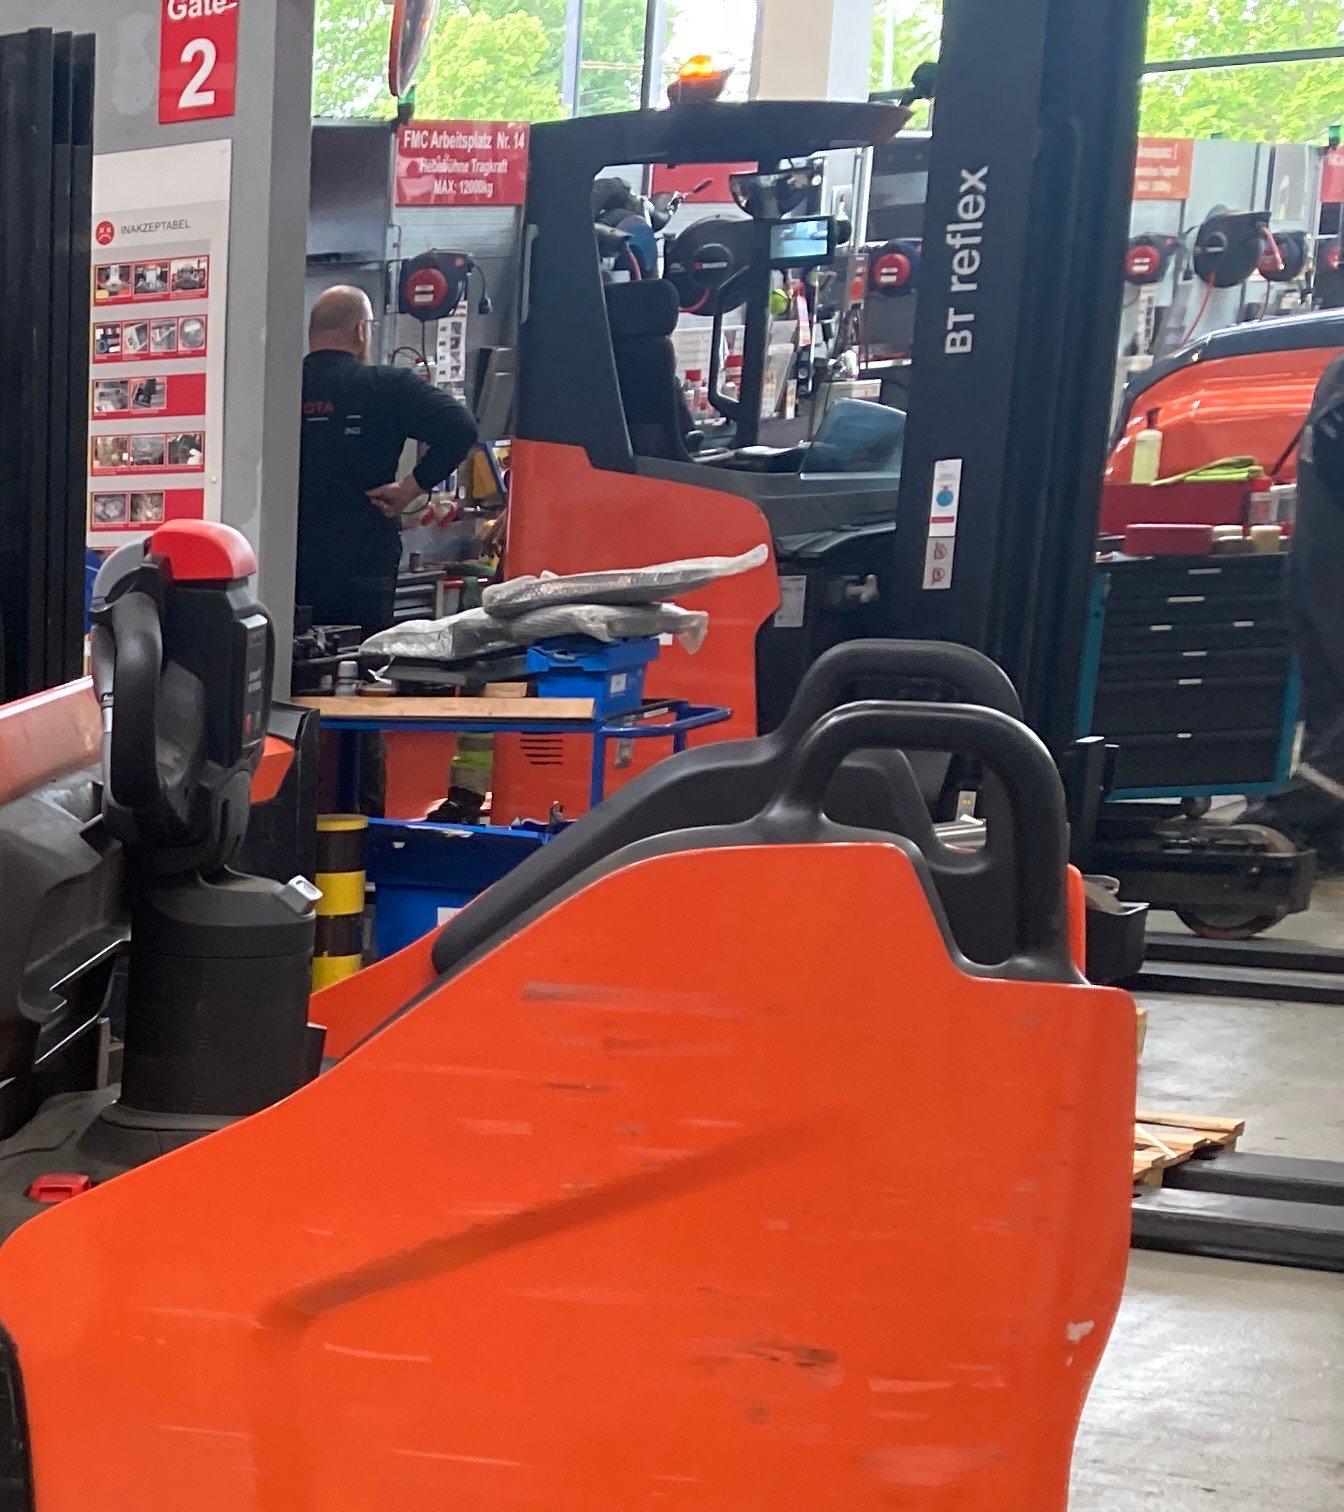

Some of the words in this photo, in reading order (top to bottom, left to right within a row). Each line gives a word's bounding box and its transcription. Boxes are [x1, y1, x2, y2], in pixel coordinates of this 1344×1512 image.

[178, 37, 217, 109] 2
[403, 130, 429, 149] FMC
[430, 130, 493, 152] Arbeitsplatz
[496, 131, 511, 149] Nr.
[513, 132, 525, 149] 14
[120, 219, 190, 235] INAKZEPTABEL
[946, 165, 989, 292] reflex
[944, 307, 974, 354] BT
